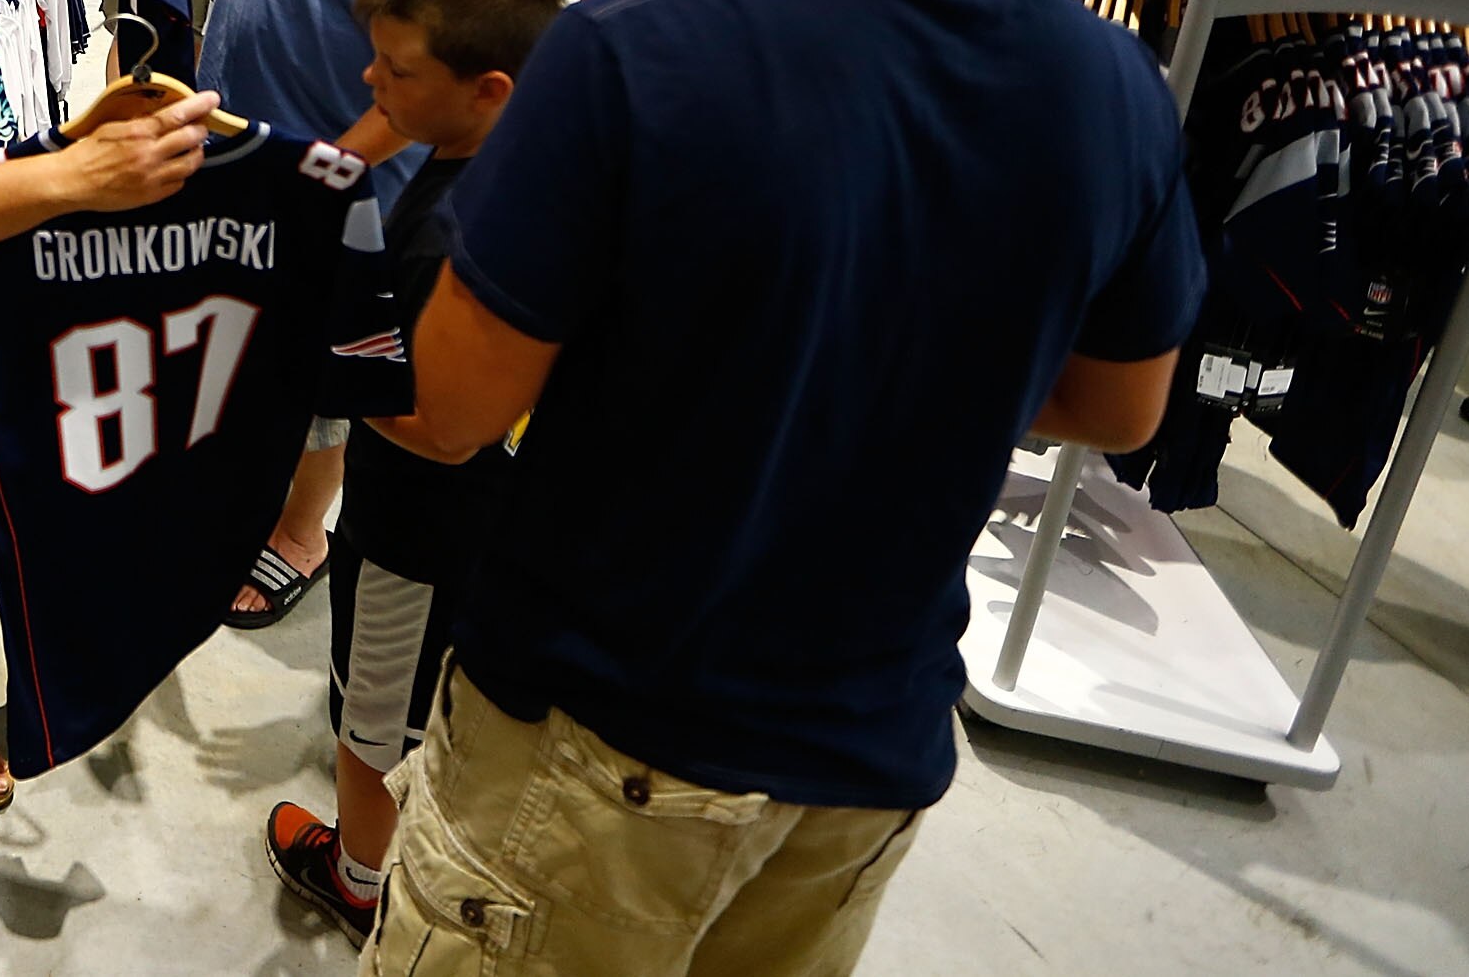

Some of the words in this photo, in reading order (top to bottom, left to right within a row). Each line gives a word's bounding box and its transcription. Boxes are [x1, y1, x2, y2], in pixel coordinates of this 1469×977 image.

[298, 140, 366, 191] 8
[32, 216, 275, 282] GRONKOWSKI
[50, 294, 262, 495] 87
